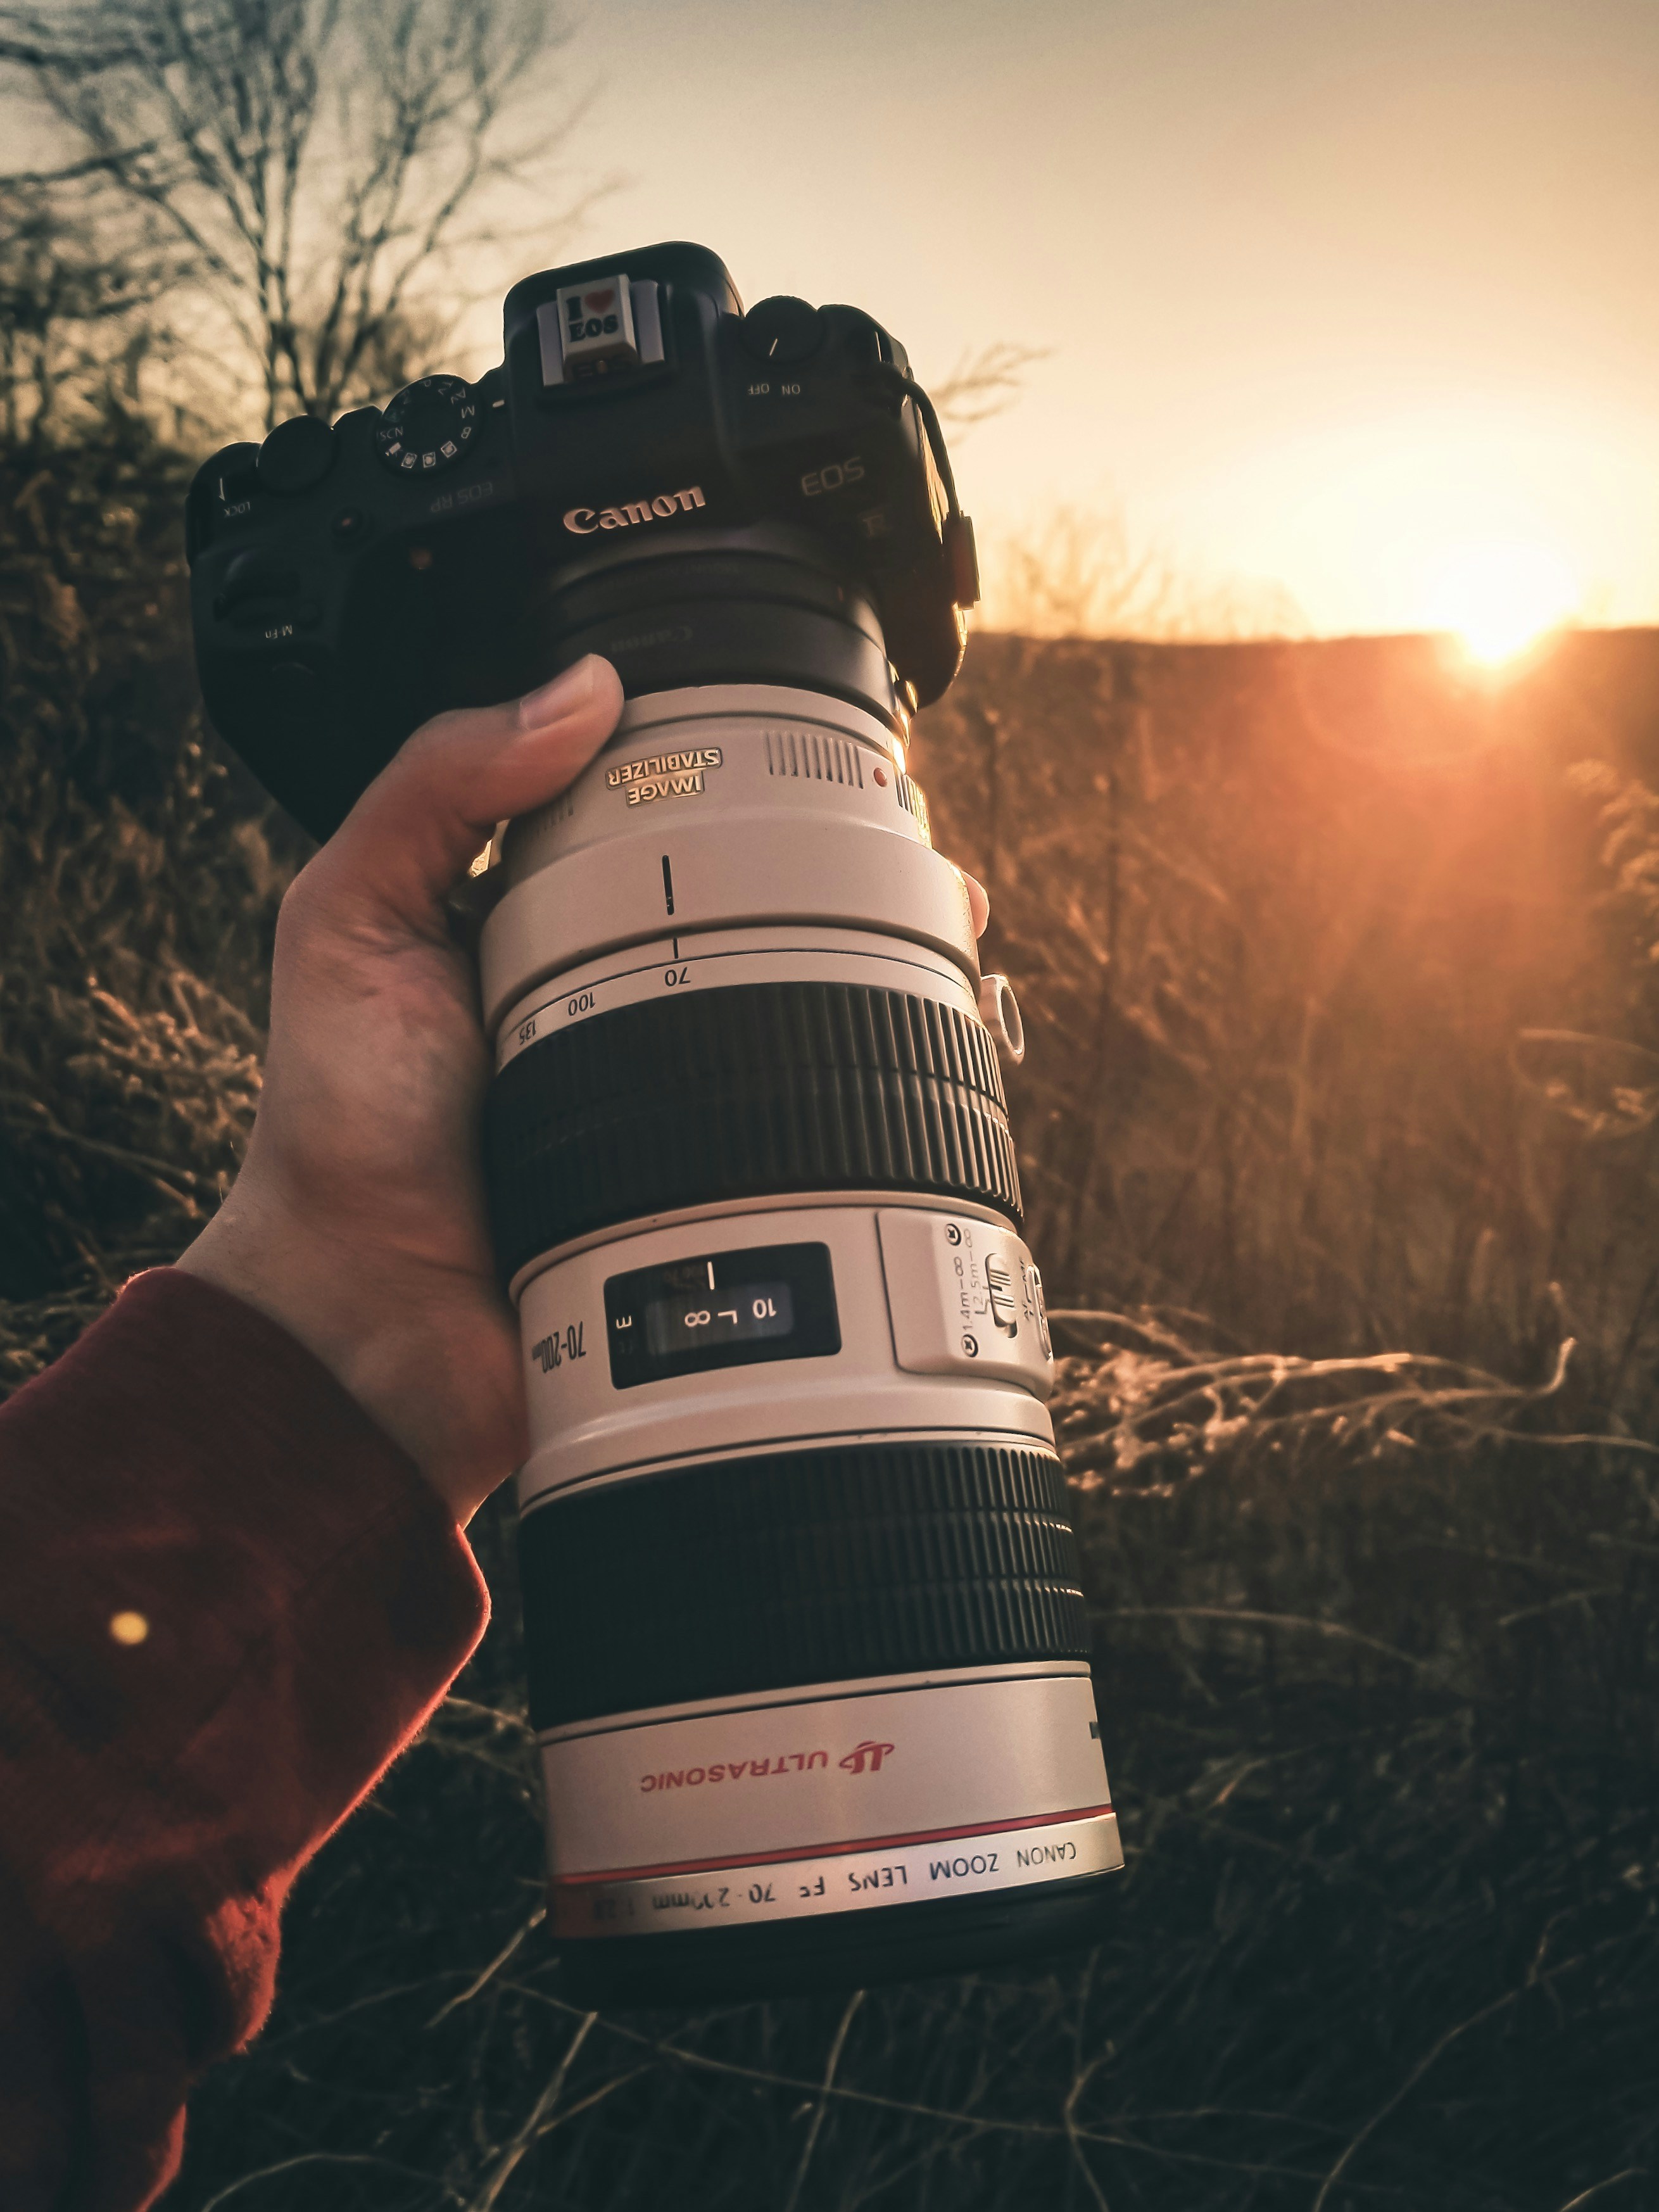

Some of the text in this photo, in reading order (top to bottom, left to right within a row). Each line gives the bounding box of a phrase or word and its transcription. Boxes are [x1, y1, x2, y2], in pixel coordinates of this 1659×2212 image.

[566, 296, 583, 321] I
[569, 315, 619, 343] EOS
[747, 384, 770, 396] OFF
[781, 384, 800, 395] ON
[462, 405, 476, 419] M
[380, 426, 404, 441] SCN
[461, 427, 472, 439] B
[801, 456, 866, 496] EOS
[457, 481, 493, 507] EOS
[224, 501, 251, 518] LOCK
[563, 485, 706, 534] Canon
[609, 749, 720, 788] STABILIZER
[628, 774, 703, 806] IMAGE
[664, 968, 691, 987] 70
[567, 992, 596, 1017] 100
[519, 1020, 537, 1046] 135
[752, 1298, 777, 1319] 10
[640, 1750, 828, 1793] ULTRASONIC
[930, 1852, 1000, 1882] ZOOM
[1017, 1842, 1077, 1869] CANON
[848, 1864, 908, 1893] LENS
